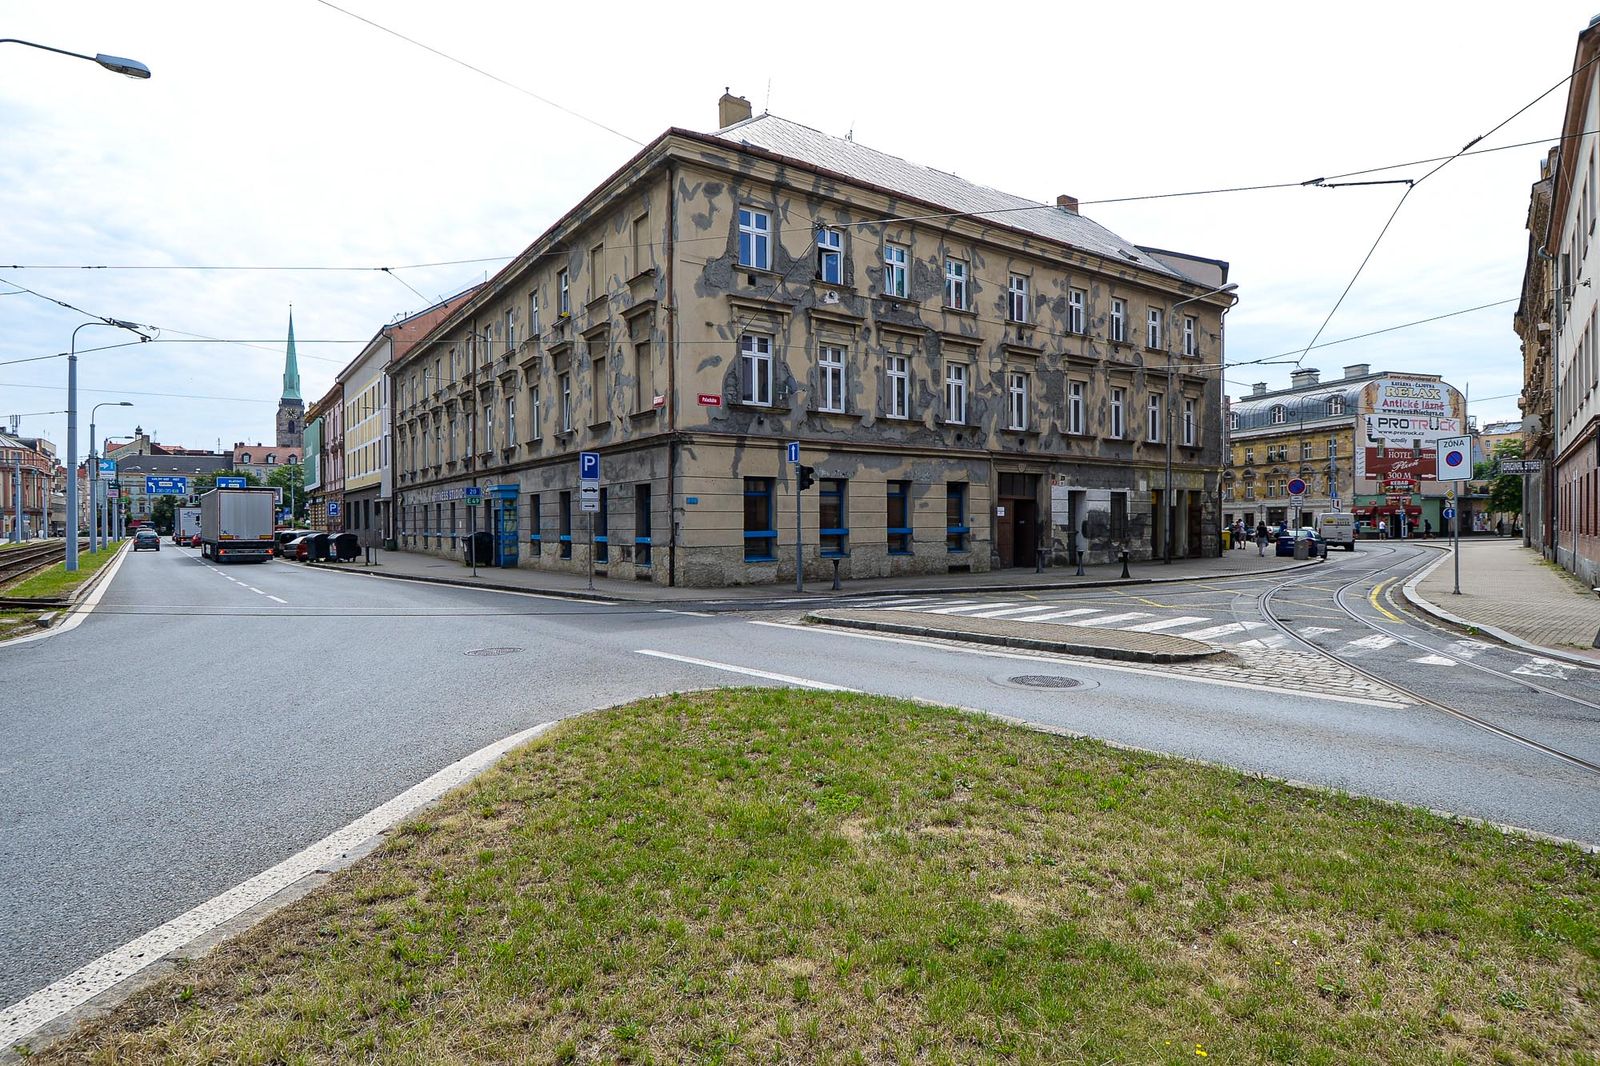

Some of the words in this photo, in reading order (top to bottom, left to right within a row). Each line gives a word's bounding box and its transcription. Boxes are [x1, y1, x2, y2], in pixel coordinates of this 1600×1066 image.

[1385, 386, 1441, 400] RELAX
[1382, 399, 1419, 409] Antické
[1422, 400, 1445, 411] lázně
[1378, 417, 1456, 432] PROTRUCK
[1388, 451, 1412, 459] HOTEL
[584, 455, 596, 471] P
[329, 503, 337, 511] P
